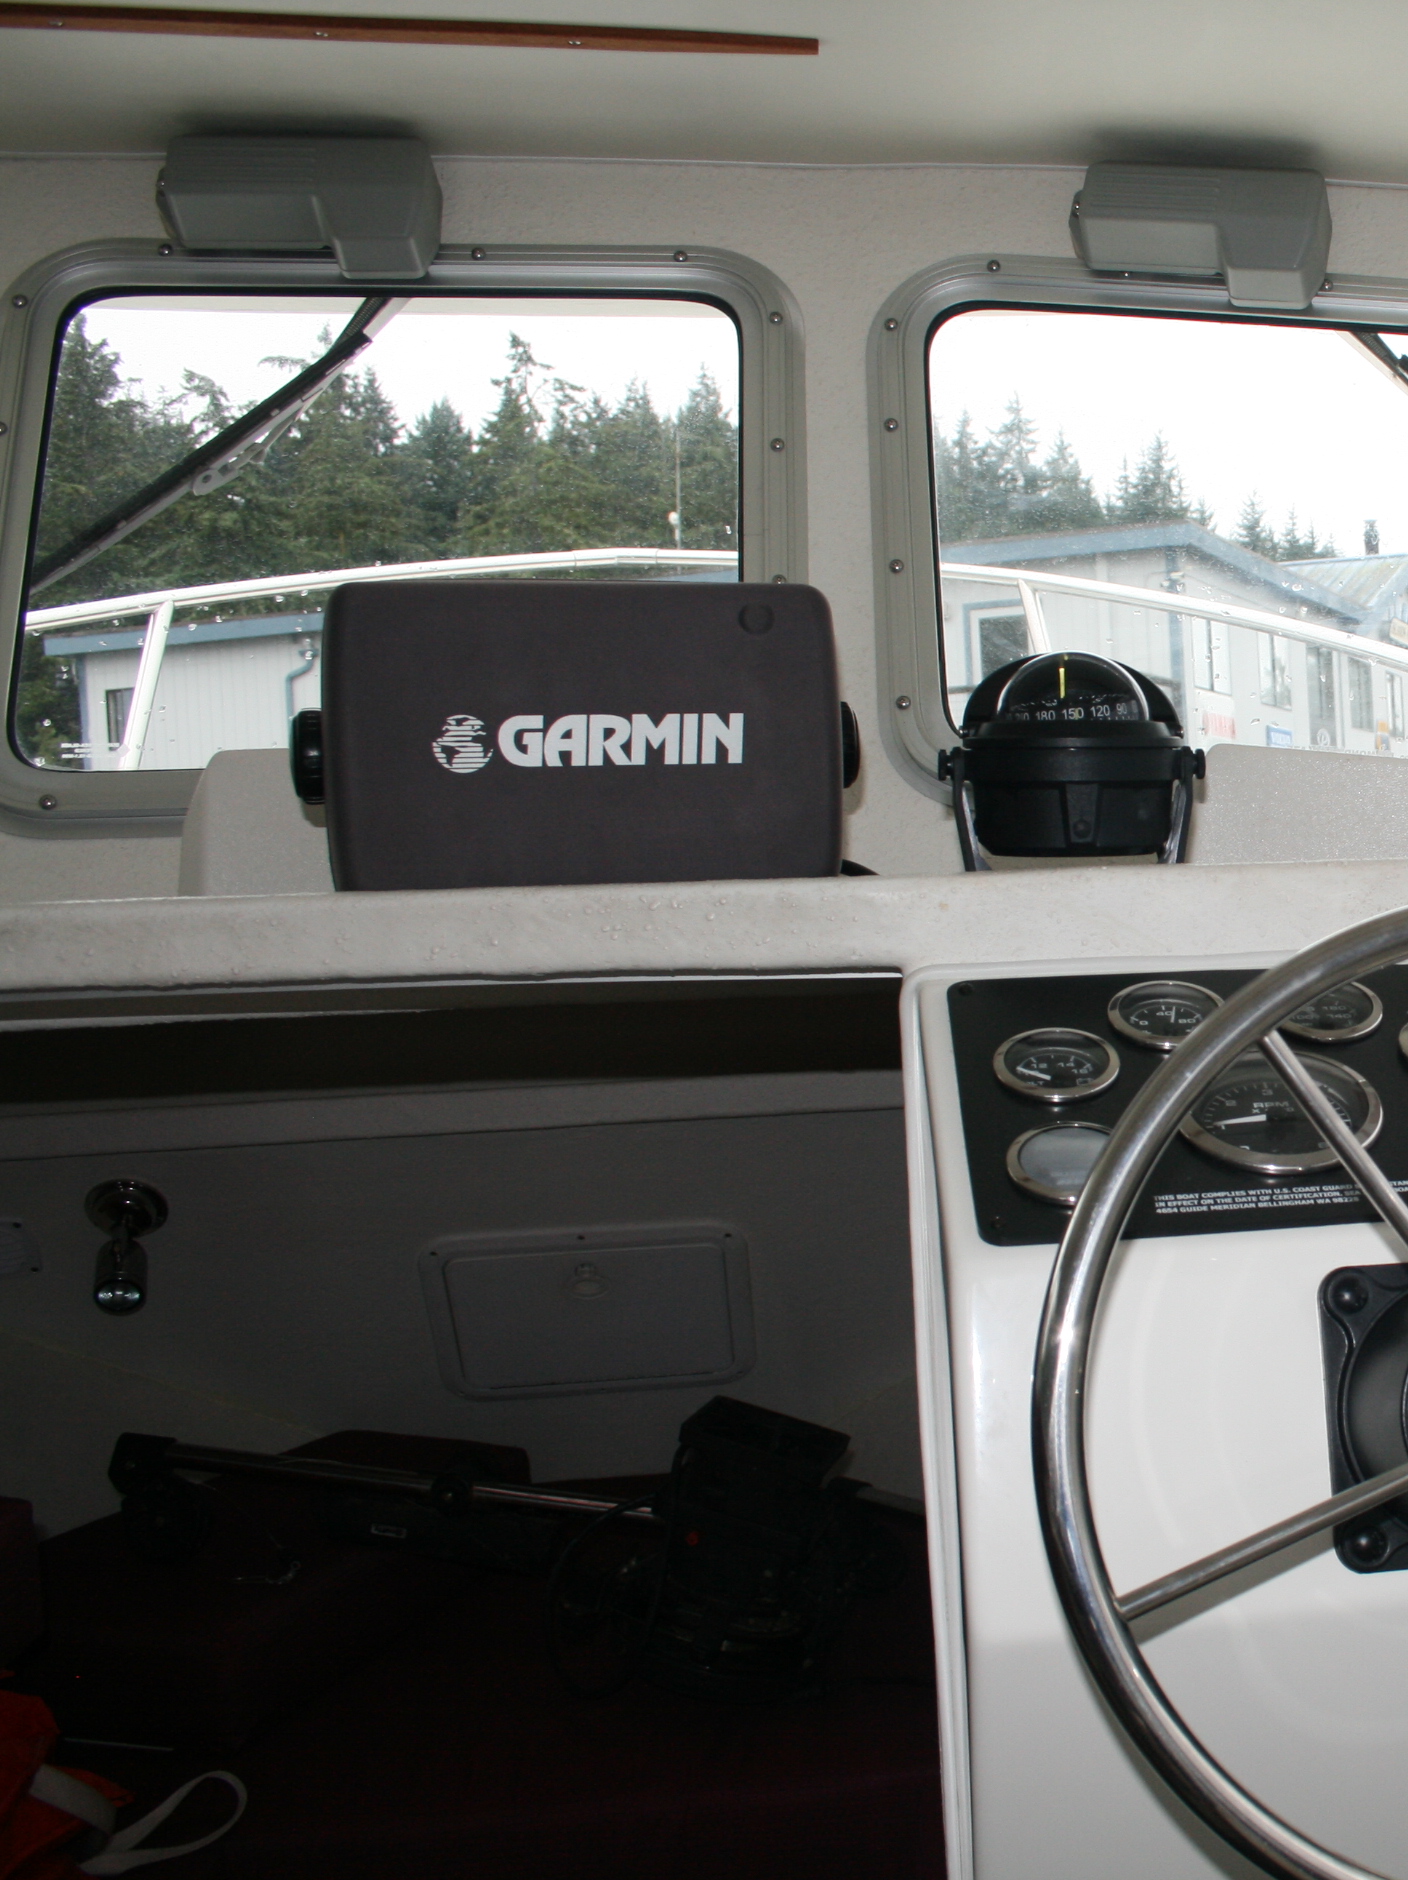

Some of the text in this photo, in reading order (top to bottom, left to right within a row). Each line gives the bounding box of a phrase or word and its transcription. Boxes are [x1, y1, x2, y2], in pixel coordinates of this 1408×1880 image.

[1062, 708, 1084, 720] 150
[1090, 704, 1110, 717] 120
[1116, 702, 1128, 715] 90
[498, 712, 744, 767] GARMIN
[1031, 1062, 1048, 1070] 12
[1252, 1101, 1290, 1109] RPM
[1201, 1190, 1245, 1198] COMPLIES
[1211, 1202, 1255, 1210] MERIDIAN
[1258, 1198, 1314, 1207] BELLINGHAM
